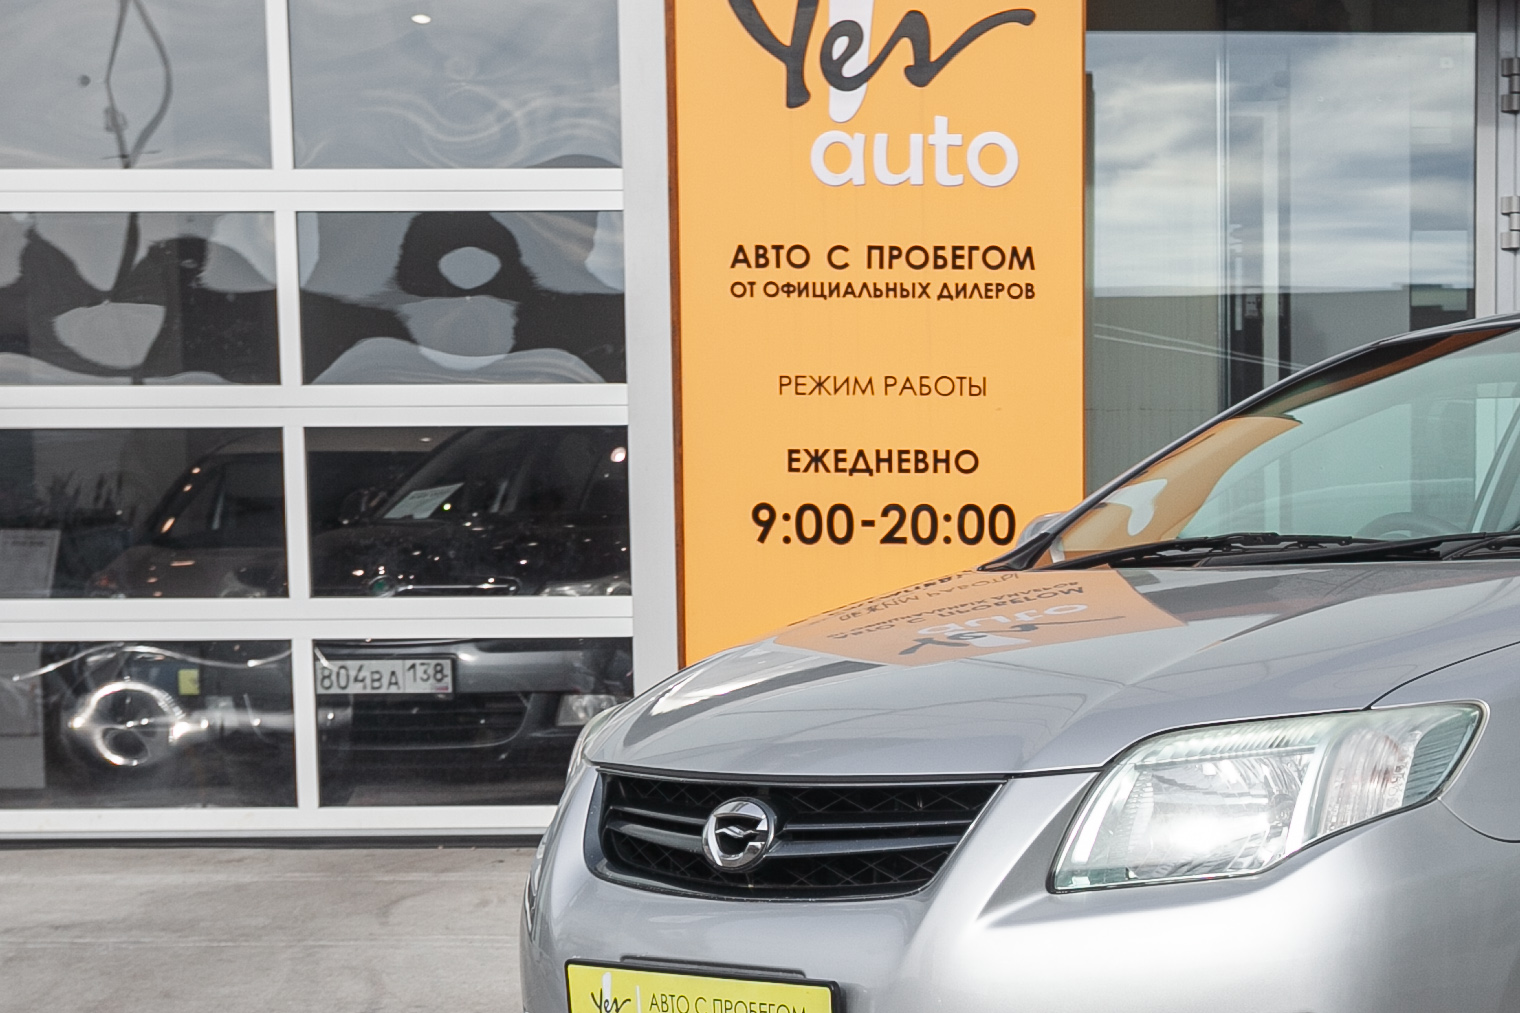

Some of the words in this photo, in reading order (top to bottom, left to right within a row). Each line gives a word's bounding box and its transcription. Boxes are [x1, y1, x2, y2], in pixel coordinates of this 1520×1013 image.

[727, 0, 1036, 109] Yes
[810, 116, 1019, 187] auto
[730, 244, 811, 270] АВТО
[826, 244, 850, 271] С
[866, 244, 1036, 271] ПРОБЕГОМ
[730, 281, 757, 299] ОТ
[762, 280, 932, 301] ОФИЦИАЛЬНЫХ
[936, 282, 1036, 301] ДИЛЕРОВ
[778, 375, 875, 396] РЕЖИМ
[884, 375, 987, 397] РАБОТЫ
[787, 448, 980, 477] ЕЖЕДНЕВНО
[751, 502, 1017, 546] 9:00-20:00
[406, 661, 448, 684] 138
